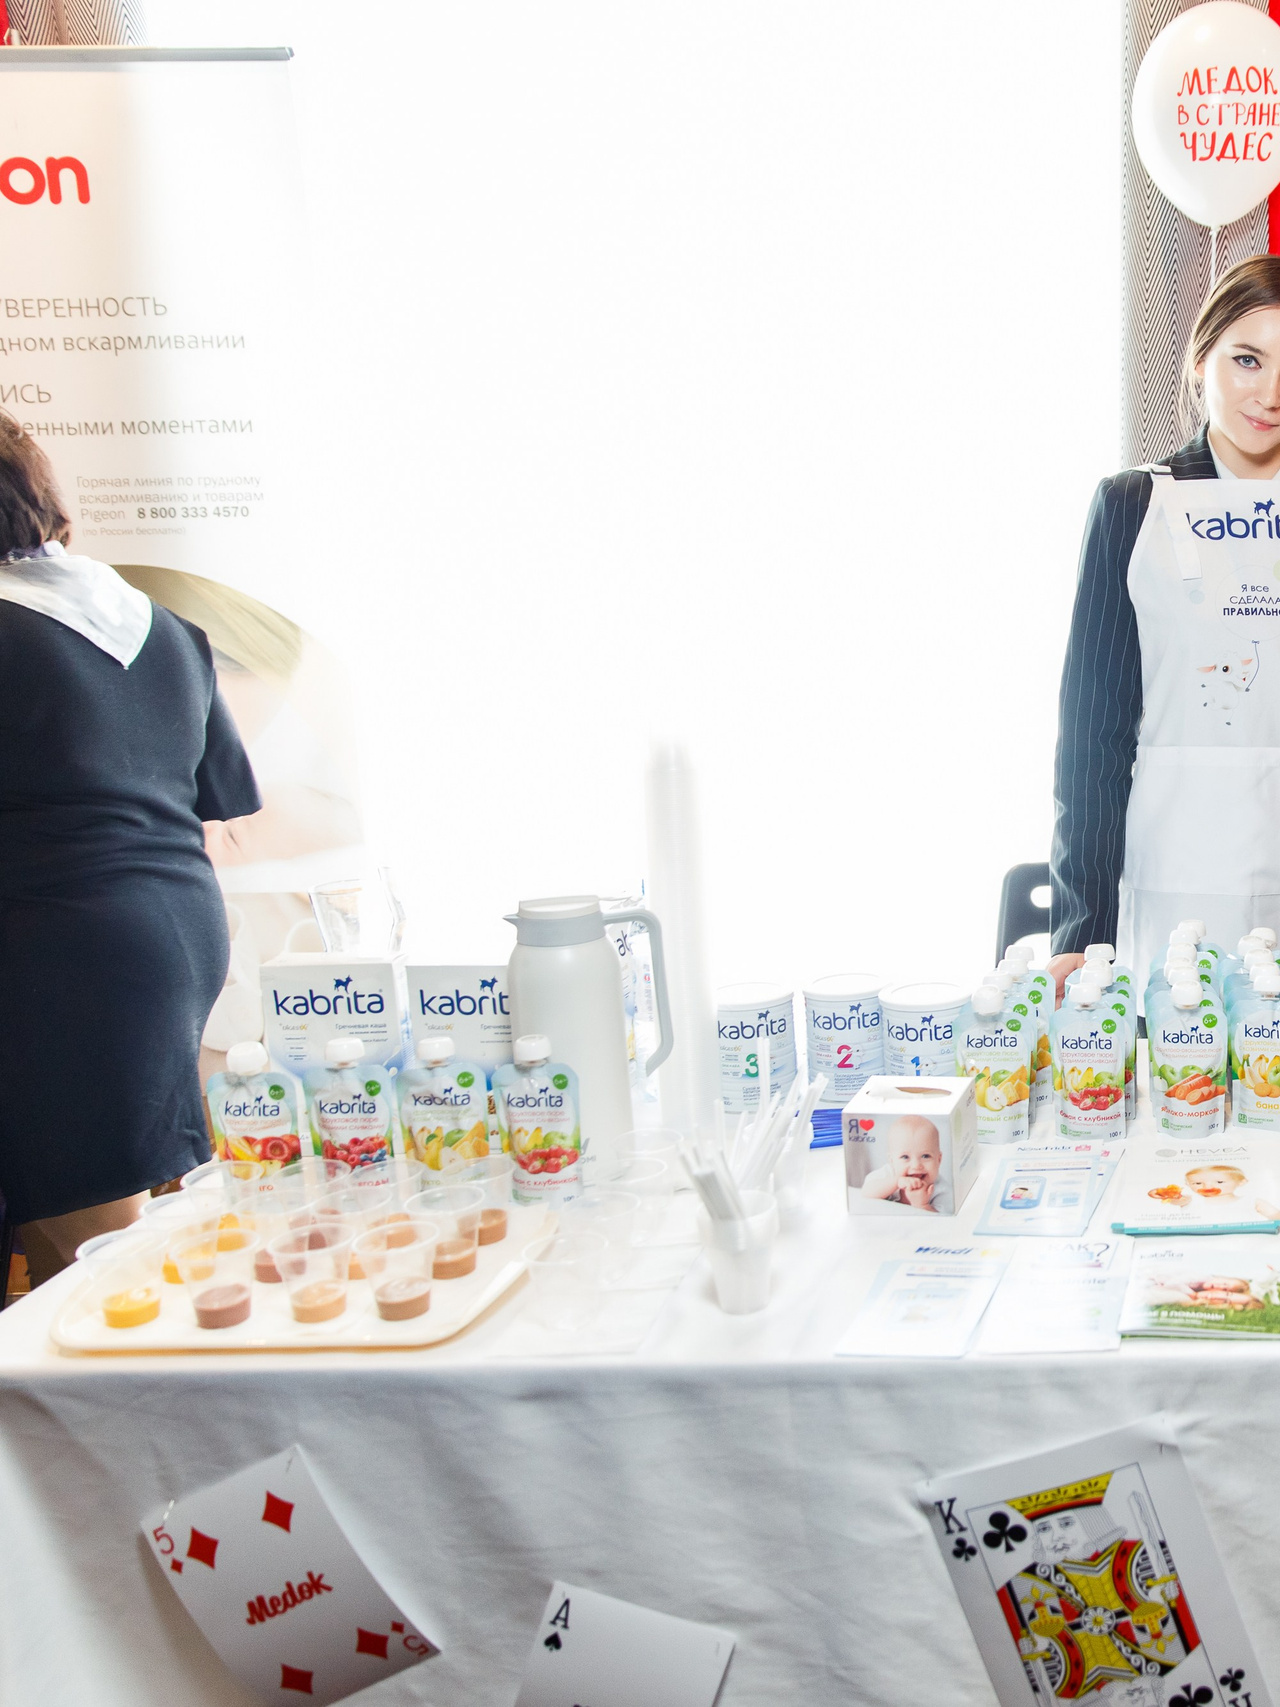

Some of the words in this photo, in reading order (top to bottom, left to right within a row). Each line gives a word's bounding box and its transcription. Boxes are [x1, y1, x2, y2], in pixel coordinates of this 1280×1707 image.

[1177, 66, 1278, 97] МЕДОК
[1196, 102, 1280, 126] СТРАНЕ
[1180, 131, 1273, 164] ЧУДЕС
[0, 296, 168, 319] ВЕРЕННОСТЬ
[63, 333, 246, 357] вскармливании
[121, 418, 254, 435] моментами
[76, 477, 130, 490] Горячая
[134, 477, 172, 488] линия
[80, 508, 126, 523] Pigeon
[137, 508, 146, 519] 8
[150, 507, 177, 519] 800
[181, 507, 208, 519] 333
[212, 505, 250, 518] 4570
[1241, 584, 1248, 593] Я
[1250, 584, 1270, 593] все
[273, 989, 385, 1016] kabrita
[419, 989, 511, 1016] kabrit
[717, 1017, 787, 1040] kabrita
[812, 1010, 880, 1031] kabrita
[887, 1019, 953, 1042] kabrita
[1163, 1030, 1214, 1045] kabrita
[966, 1035, 1018, 1049] kabrita
[1061, 1035, 1113, 1050] kabrita
[744, 1053, 759, 1078] 3
[836, 1044, 854, 1069] 2
[224, 1100, 281, 1117] kabrita
[319, 1099, 377, 1115] kabrita
[412, 1092, 471, 1107] kabrita
[507, 1092, 563, 1108] kabrita
[1083, 1112, 1122, 1123] клубникой
[1160, 1105, 1220, 1118] яблоко-морковь
[849, 1119, 859, 1133] Я
[848, 1135, 876, 1143] kabrita
[533, 1175, 579, 1187] клубникой
[915, 1246, 974, 1255] Windi
[934, 1497, 968, 1535] K
[153, 1526, 175, 1556] 5
[245, 1571, 334, 1626] Medok
[550, 1598, 572, 1631] A
[402, 1633, 430, 1658] 5
